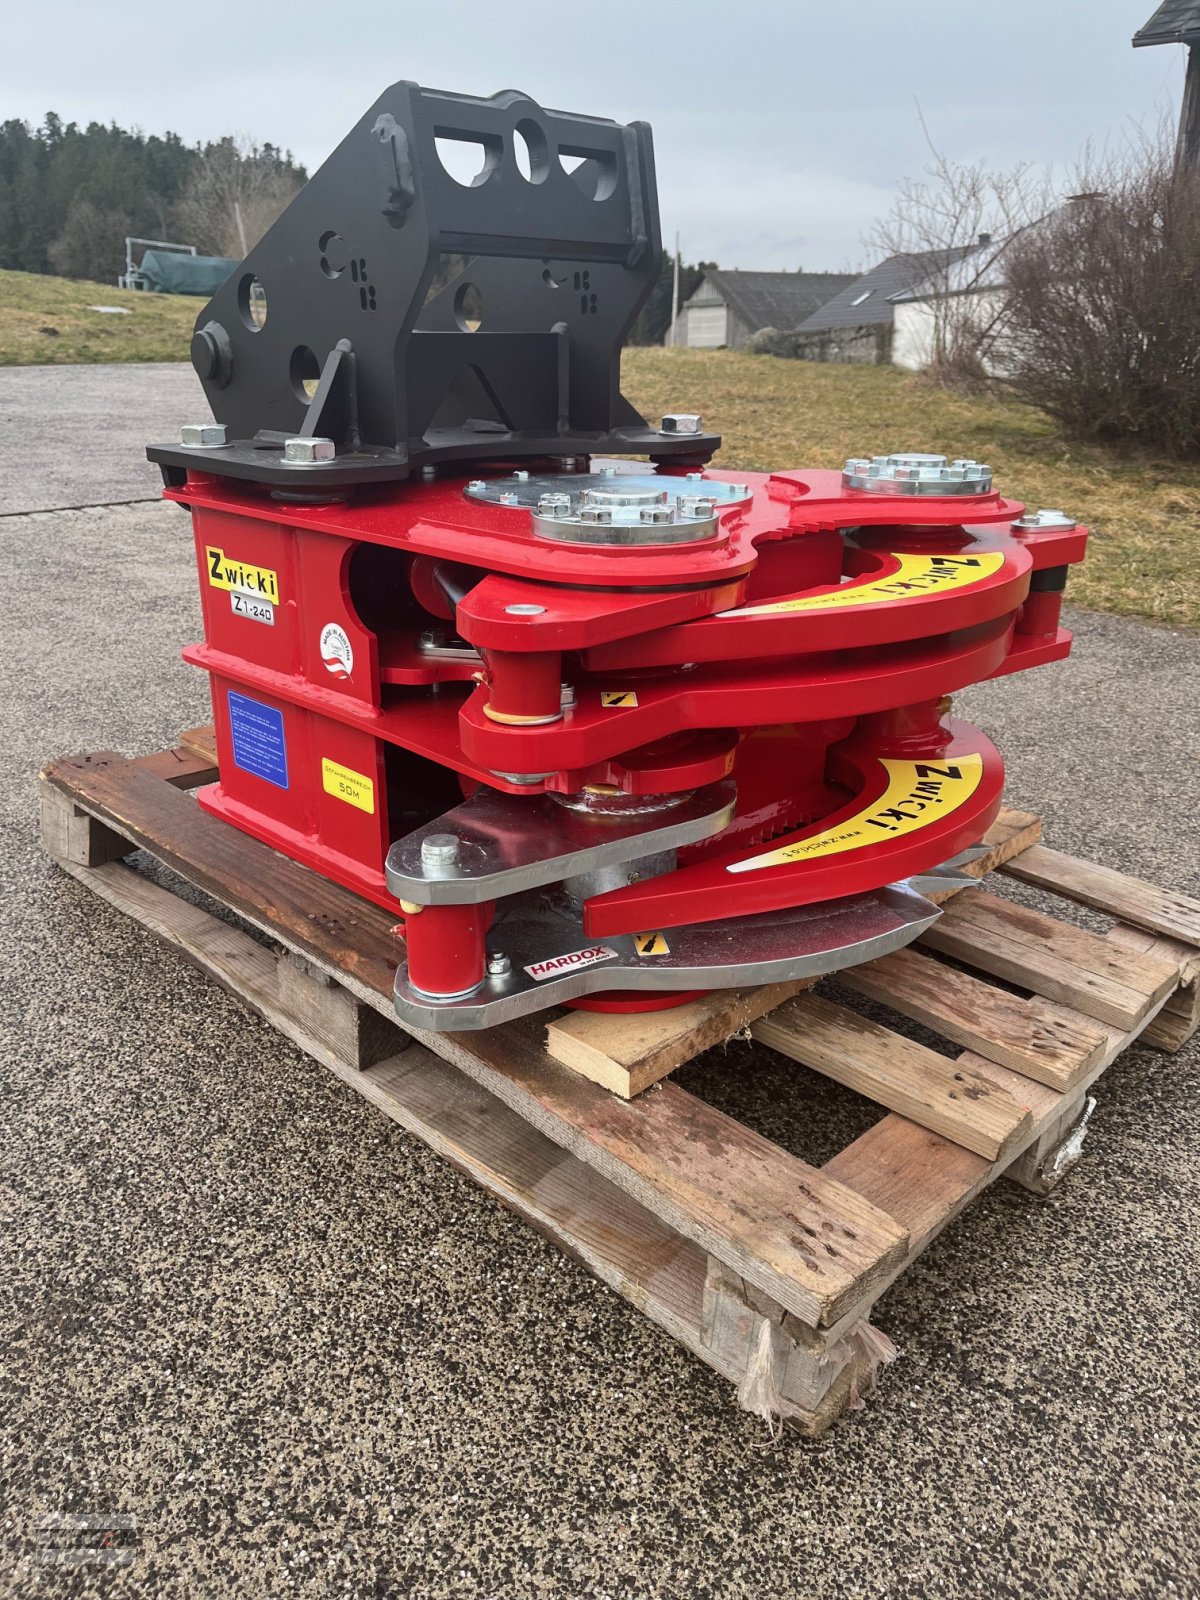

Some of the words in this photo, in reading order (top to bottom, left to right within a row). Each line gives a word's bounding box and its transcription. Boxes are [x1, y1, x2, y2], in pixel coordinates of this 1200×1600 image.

[209, 551, 275, 596] Zwicki
[871, 557, 981, 595] Zwicki
[234, 595, 272, 621] Z1-240
[865, 764, 963, 831] Zwicki
[530, 946, 606, 975] HARDOX
